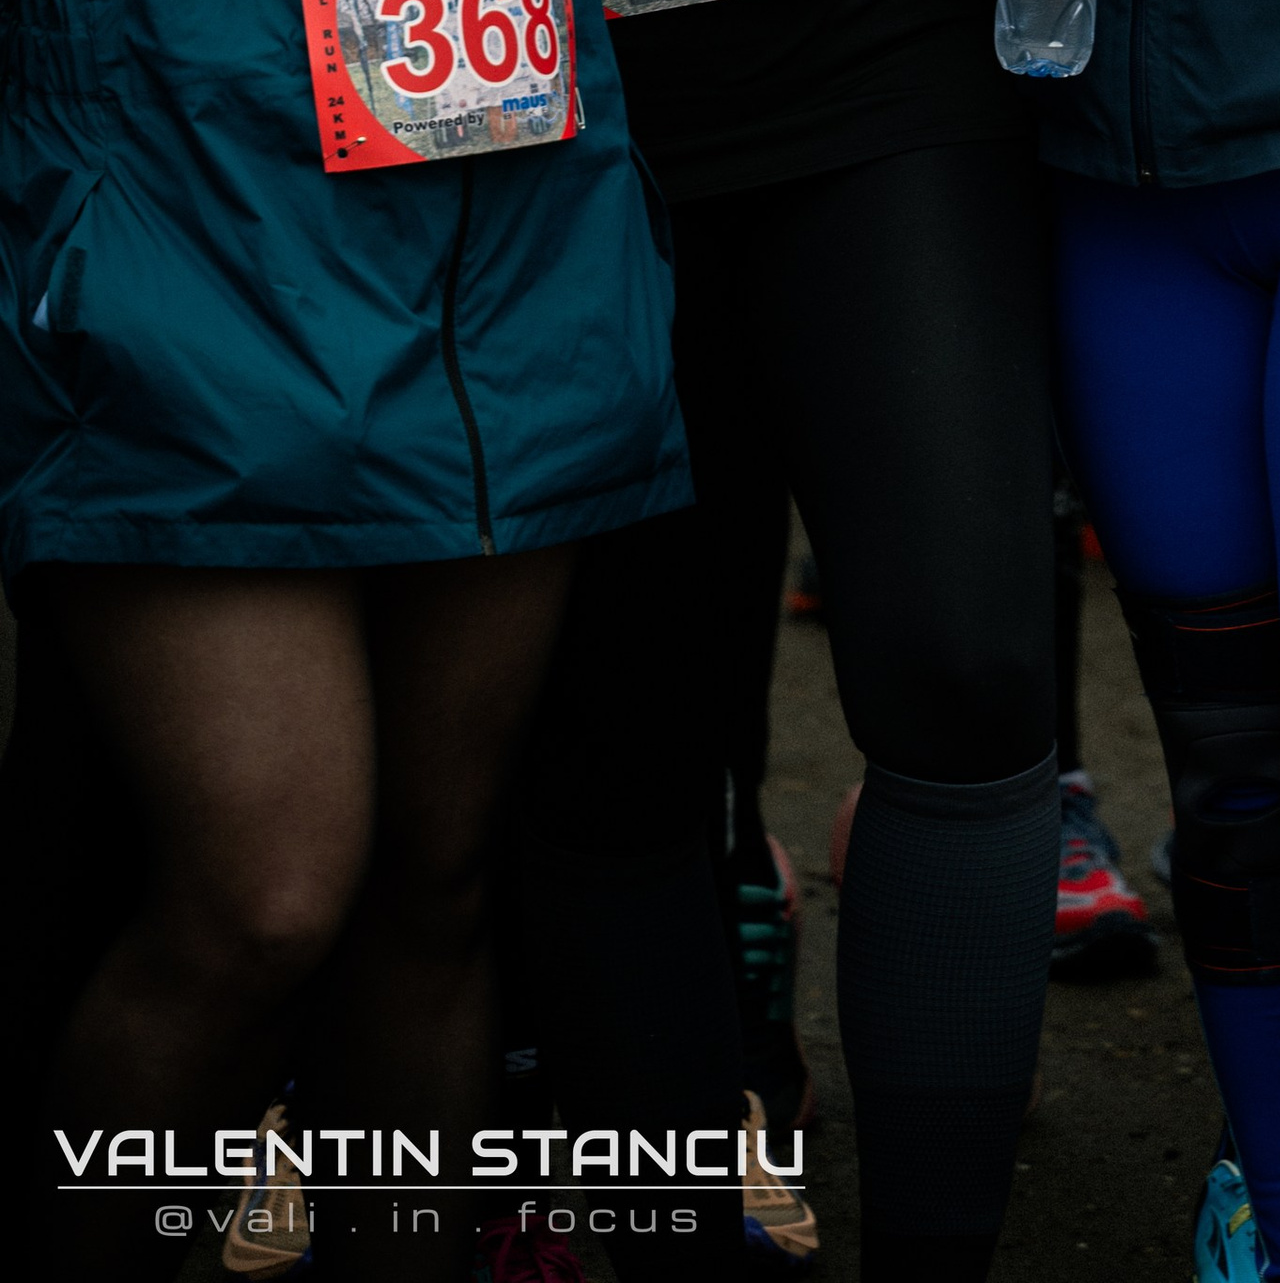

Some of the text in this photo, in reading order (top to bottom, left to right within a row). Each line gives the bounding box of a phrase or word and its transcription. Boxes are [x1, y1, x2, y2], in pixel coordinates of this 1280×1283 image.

[323, 29, 338, 74] RUN
[502, 94, 547, 113] maus
[503, 106, 549, 120] BKE
[393, 112, 485, 134] Powered by
